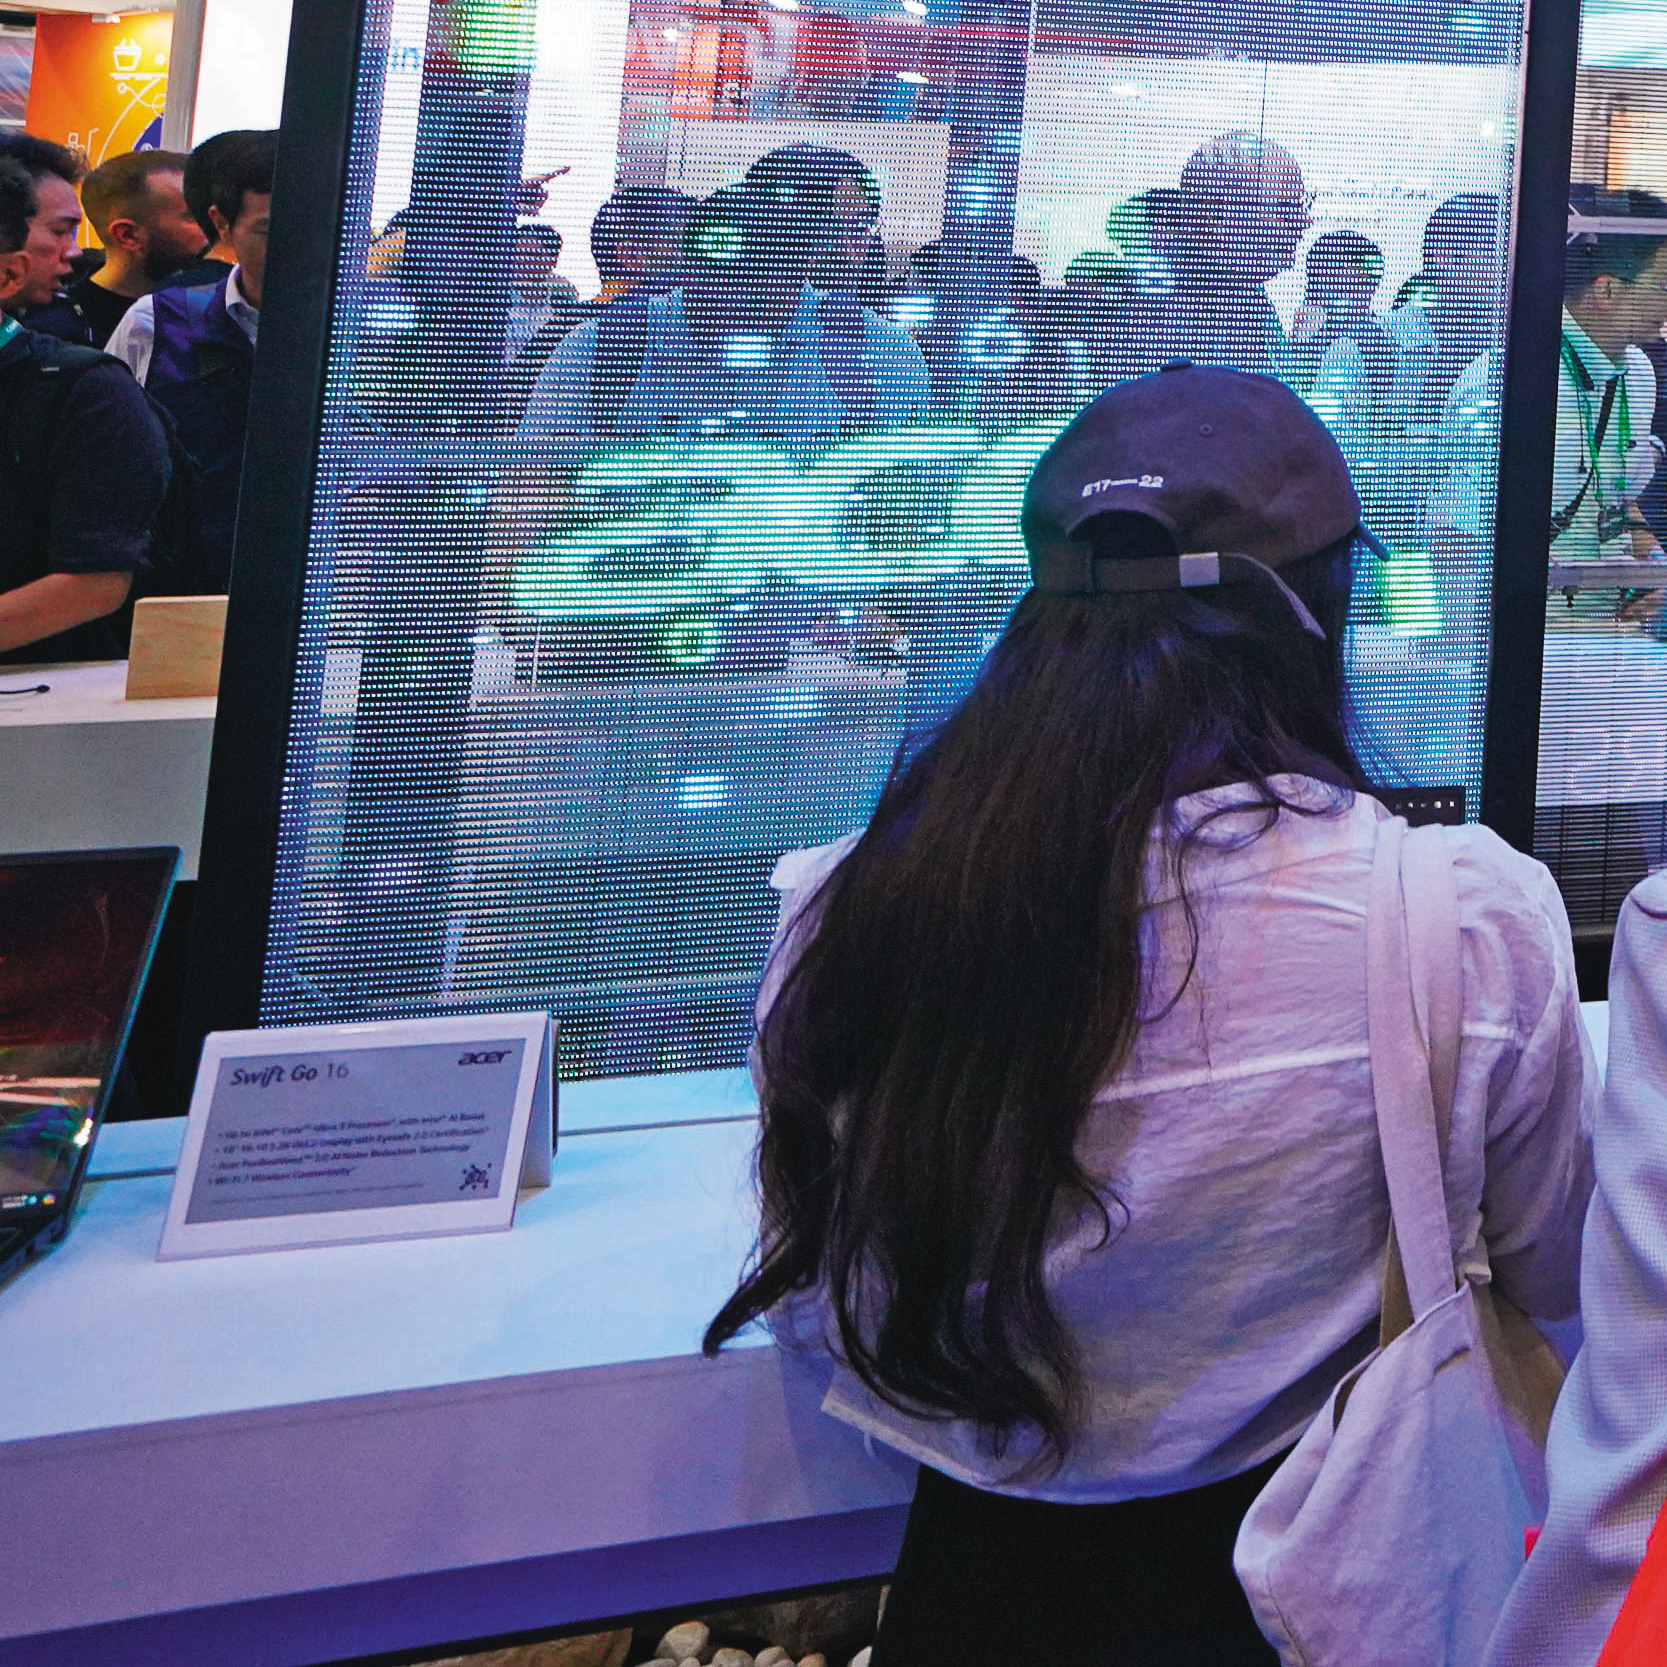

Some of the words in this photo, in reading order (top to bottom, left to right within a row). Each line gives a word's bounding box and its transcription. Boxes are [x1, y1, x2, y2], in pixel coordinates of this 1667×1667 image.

[457, 1048, 513, 1067] acer
[229, 1065, 285, 1089] Swift
[290, 1064, 319, 1083] Go
[326, 1061, 350, 1080] 16
